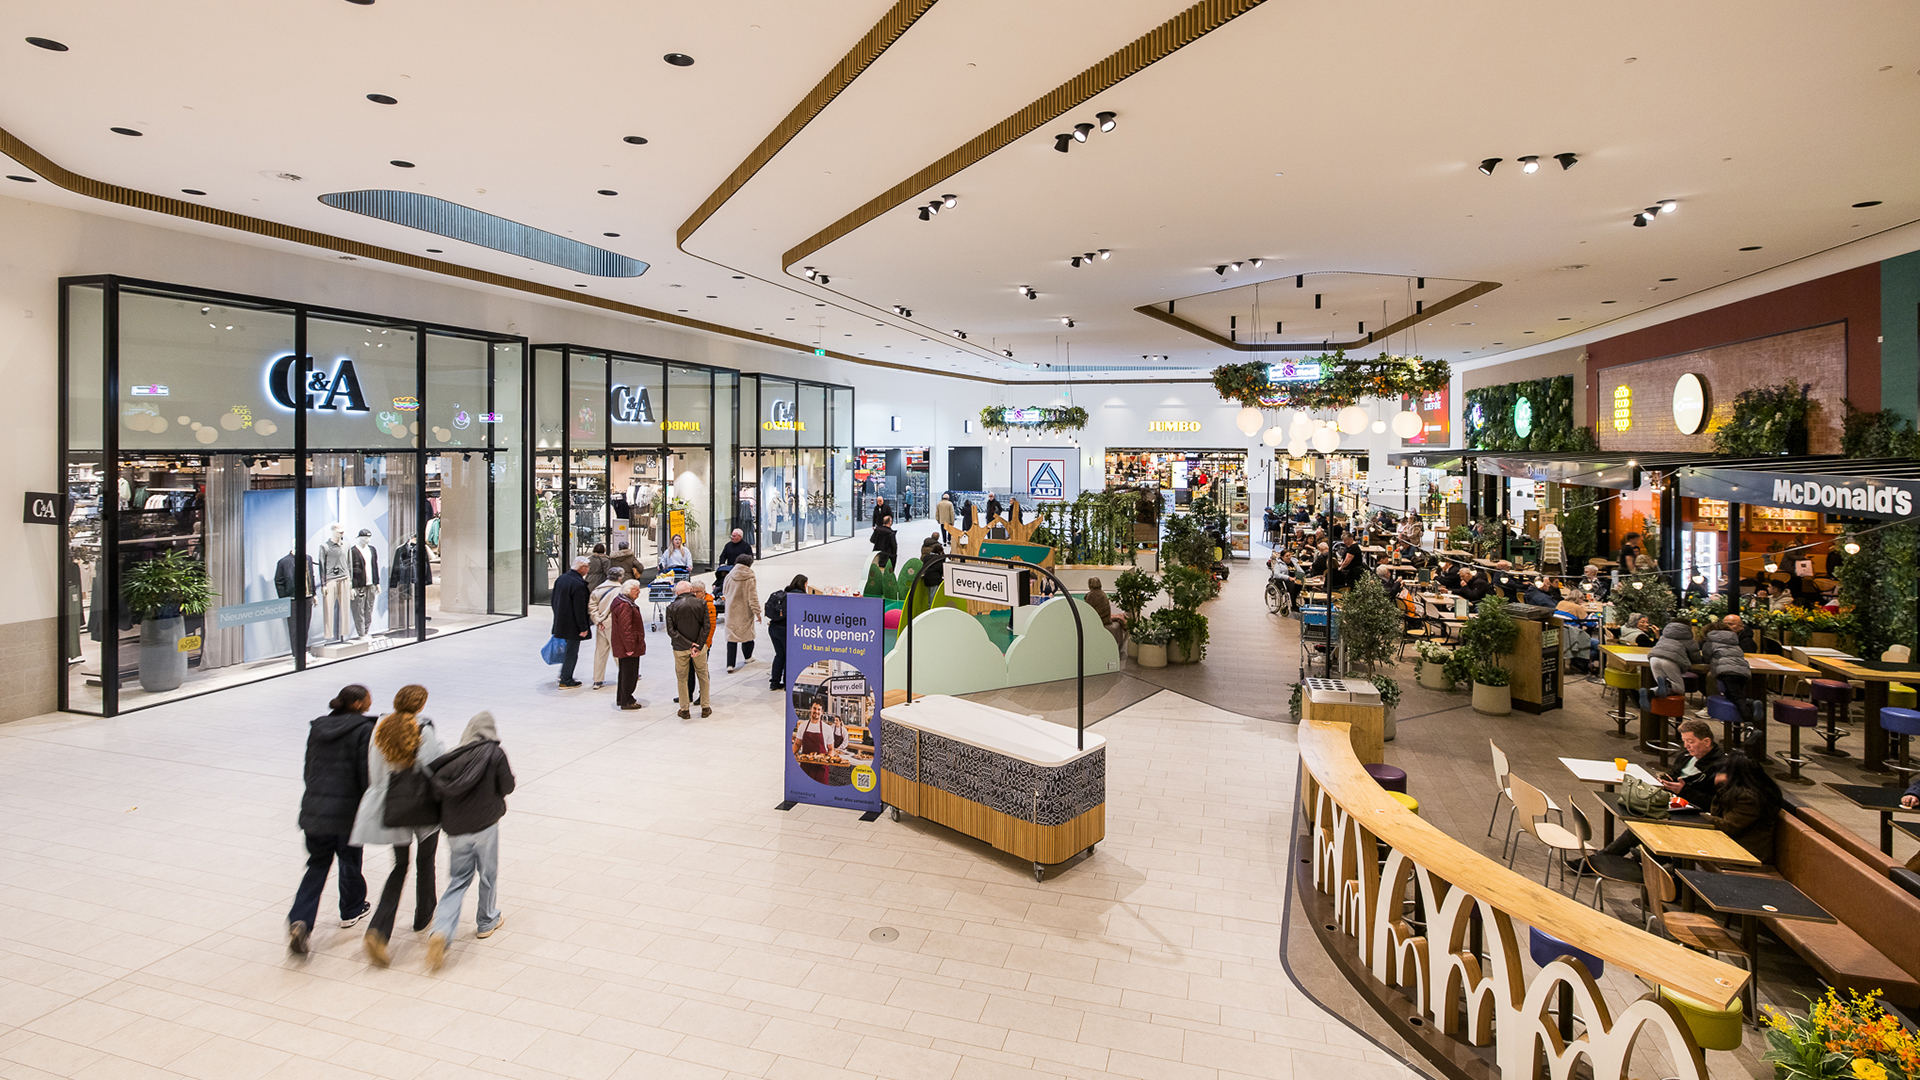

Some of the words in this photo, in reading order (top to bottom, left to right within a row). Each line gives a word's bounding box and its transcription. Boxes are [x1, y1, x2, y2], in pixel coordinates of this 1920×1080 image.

[268, 354, 370, 412] C&A
[611, 386, 655, 422] C&A
[1148, 420, 1202, 432] JUMBO
[1034, 488, 1060, 496] ALDI
[1772, 478, 1912, 516] McDonald's
[32, 498, 57, 518] C&A
[956, 576, 1003, 593] every.deli
[220, 611, 254, 622] Nieuwe
[254, 604, 289, 617] collectie
[802, 610, 832, 624] Jouw
[834, 612, 866, 628] eigen
[793, 623, 823, 639] kiosk
[826, 629, 876, 643] openen?
[853, 648, 866, 656] dag!
[832, 682, 863, 691] every.deli
